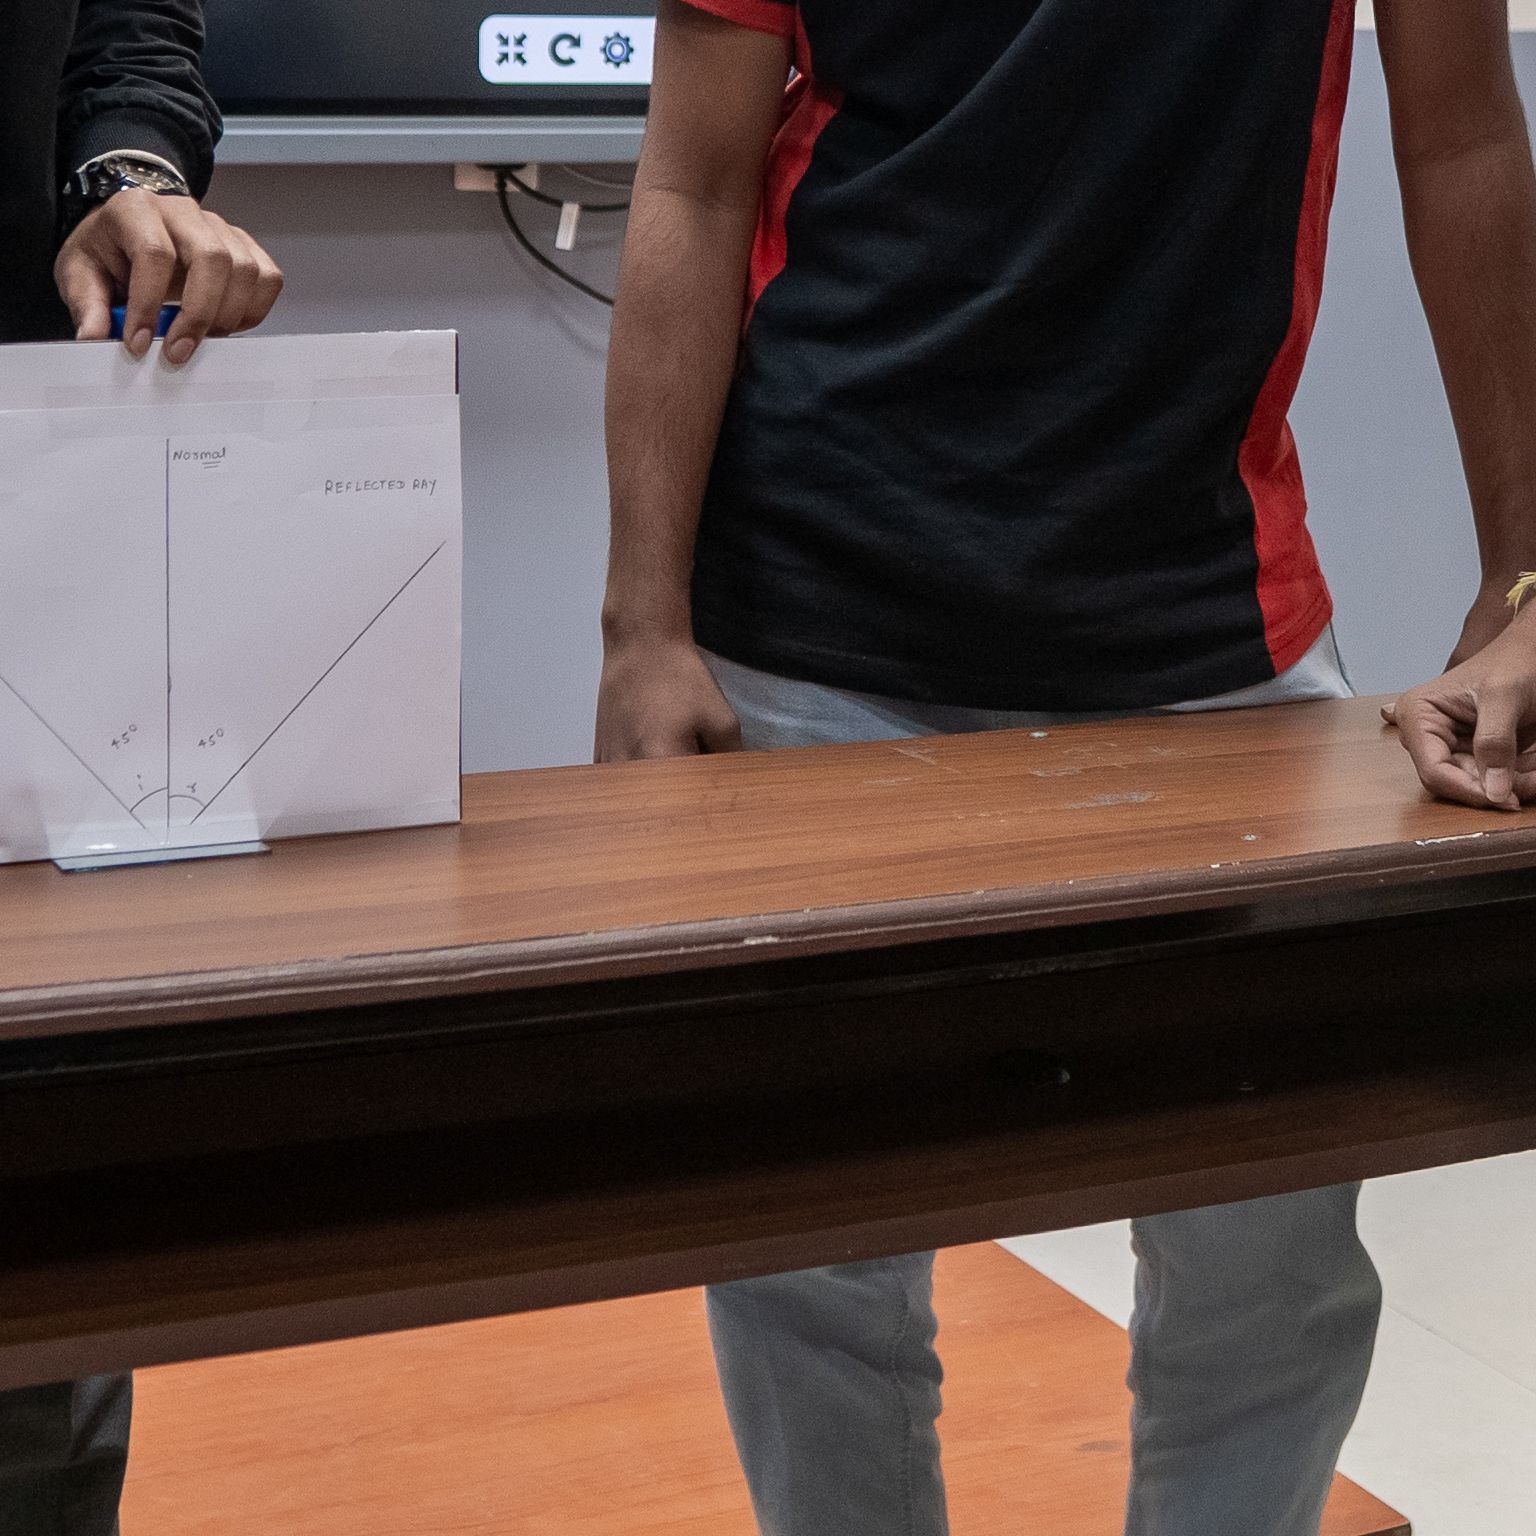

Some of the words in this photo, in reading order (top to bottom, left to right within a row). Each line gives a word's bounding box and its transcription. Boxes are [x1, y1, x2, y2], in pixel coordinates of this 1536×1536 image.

[172, 446, 226, 461] Normal
[324, 479, 406, 496] REFLECTED
[412, 478, 438, 496] RAY
